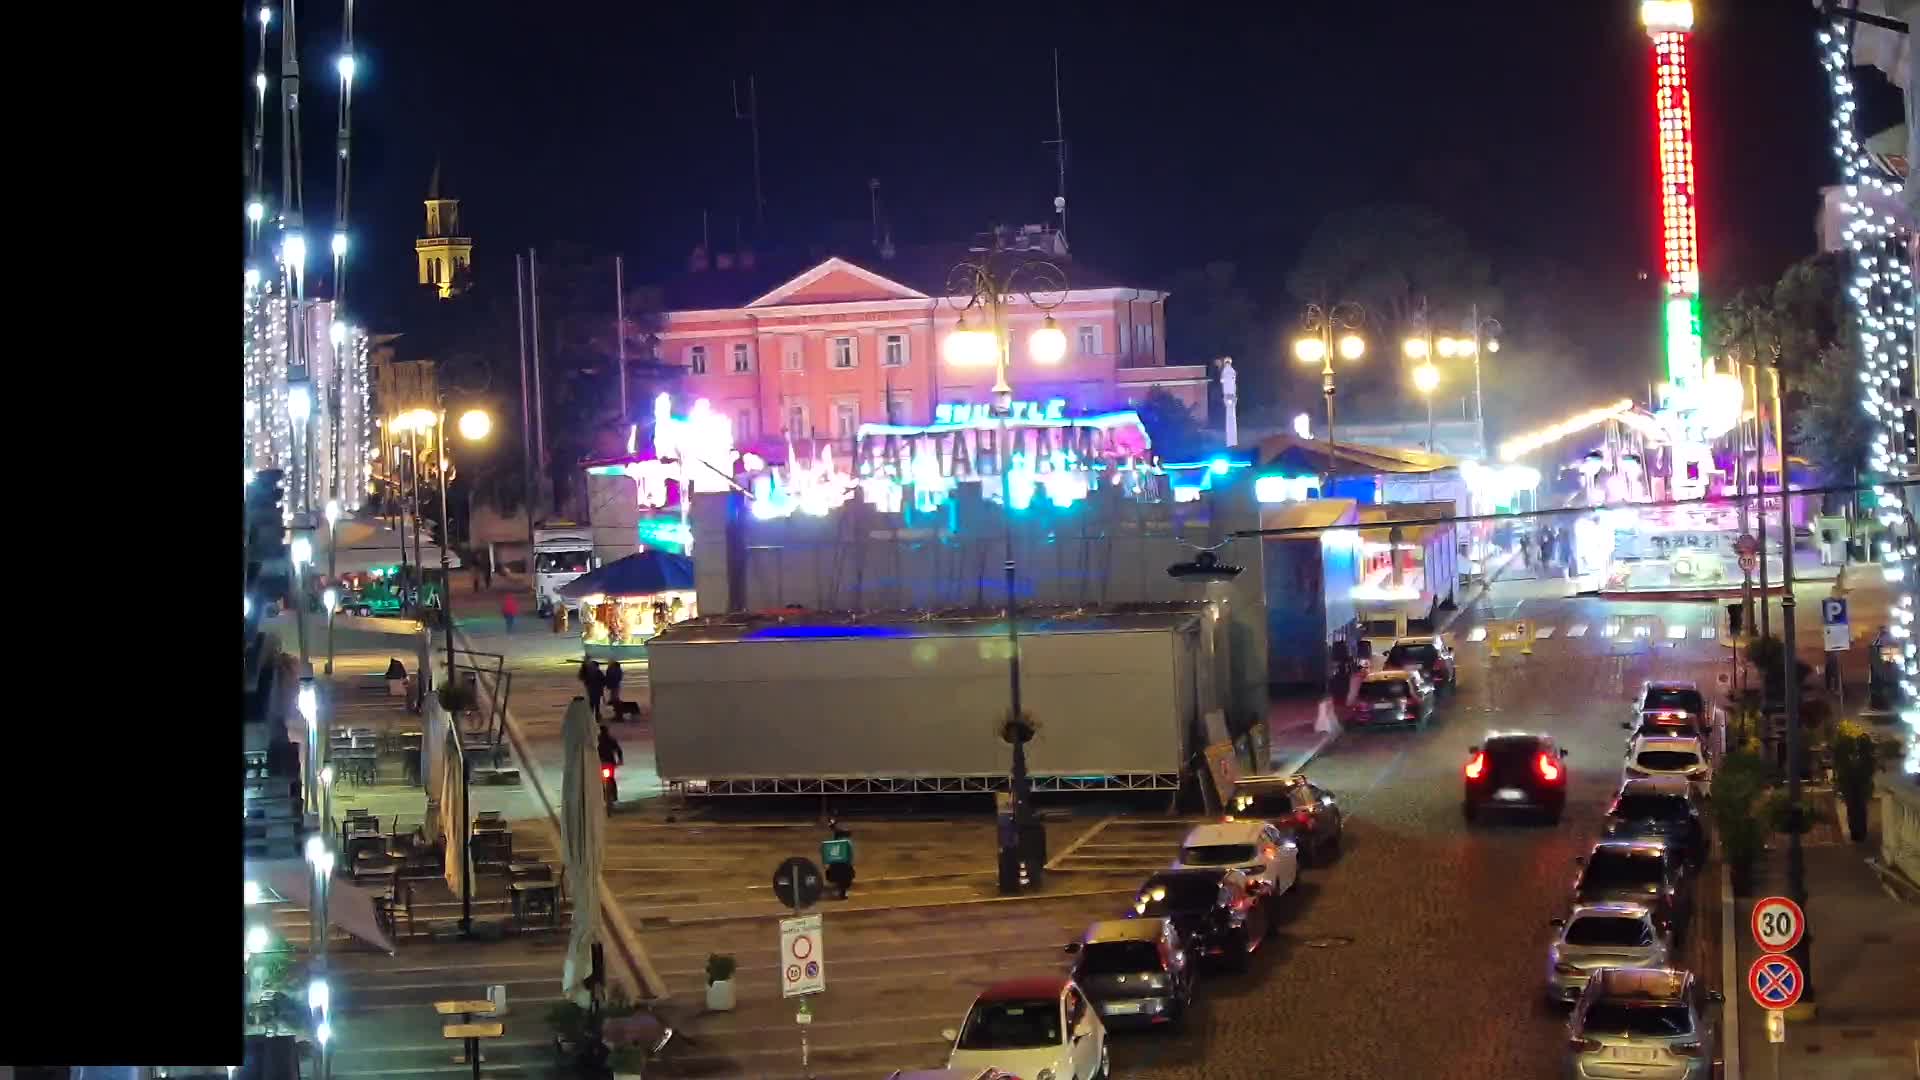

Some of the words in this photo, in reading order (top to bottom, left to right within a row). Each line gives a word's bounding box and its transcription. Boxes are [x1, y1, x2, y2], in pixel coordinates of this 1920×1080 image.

[935, 399, 1066, 424] SHUTLE
[1826, 602, 1842, 622] P
[1762, 912, 1791, 938] 30
